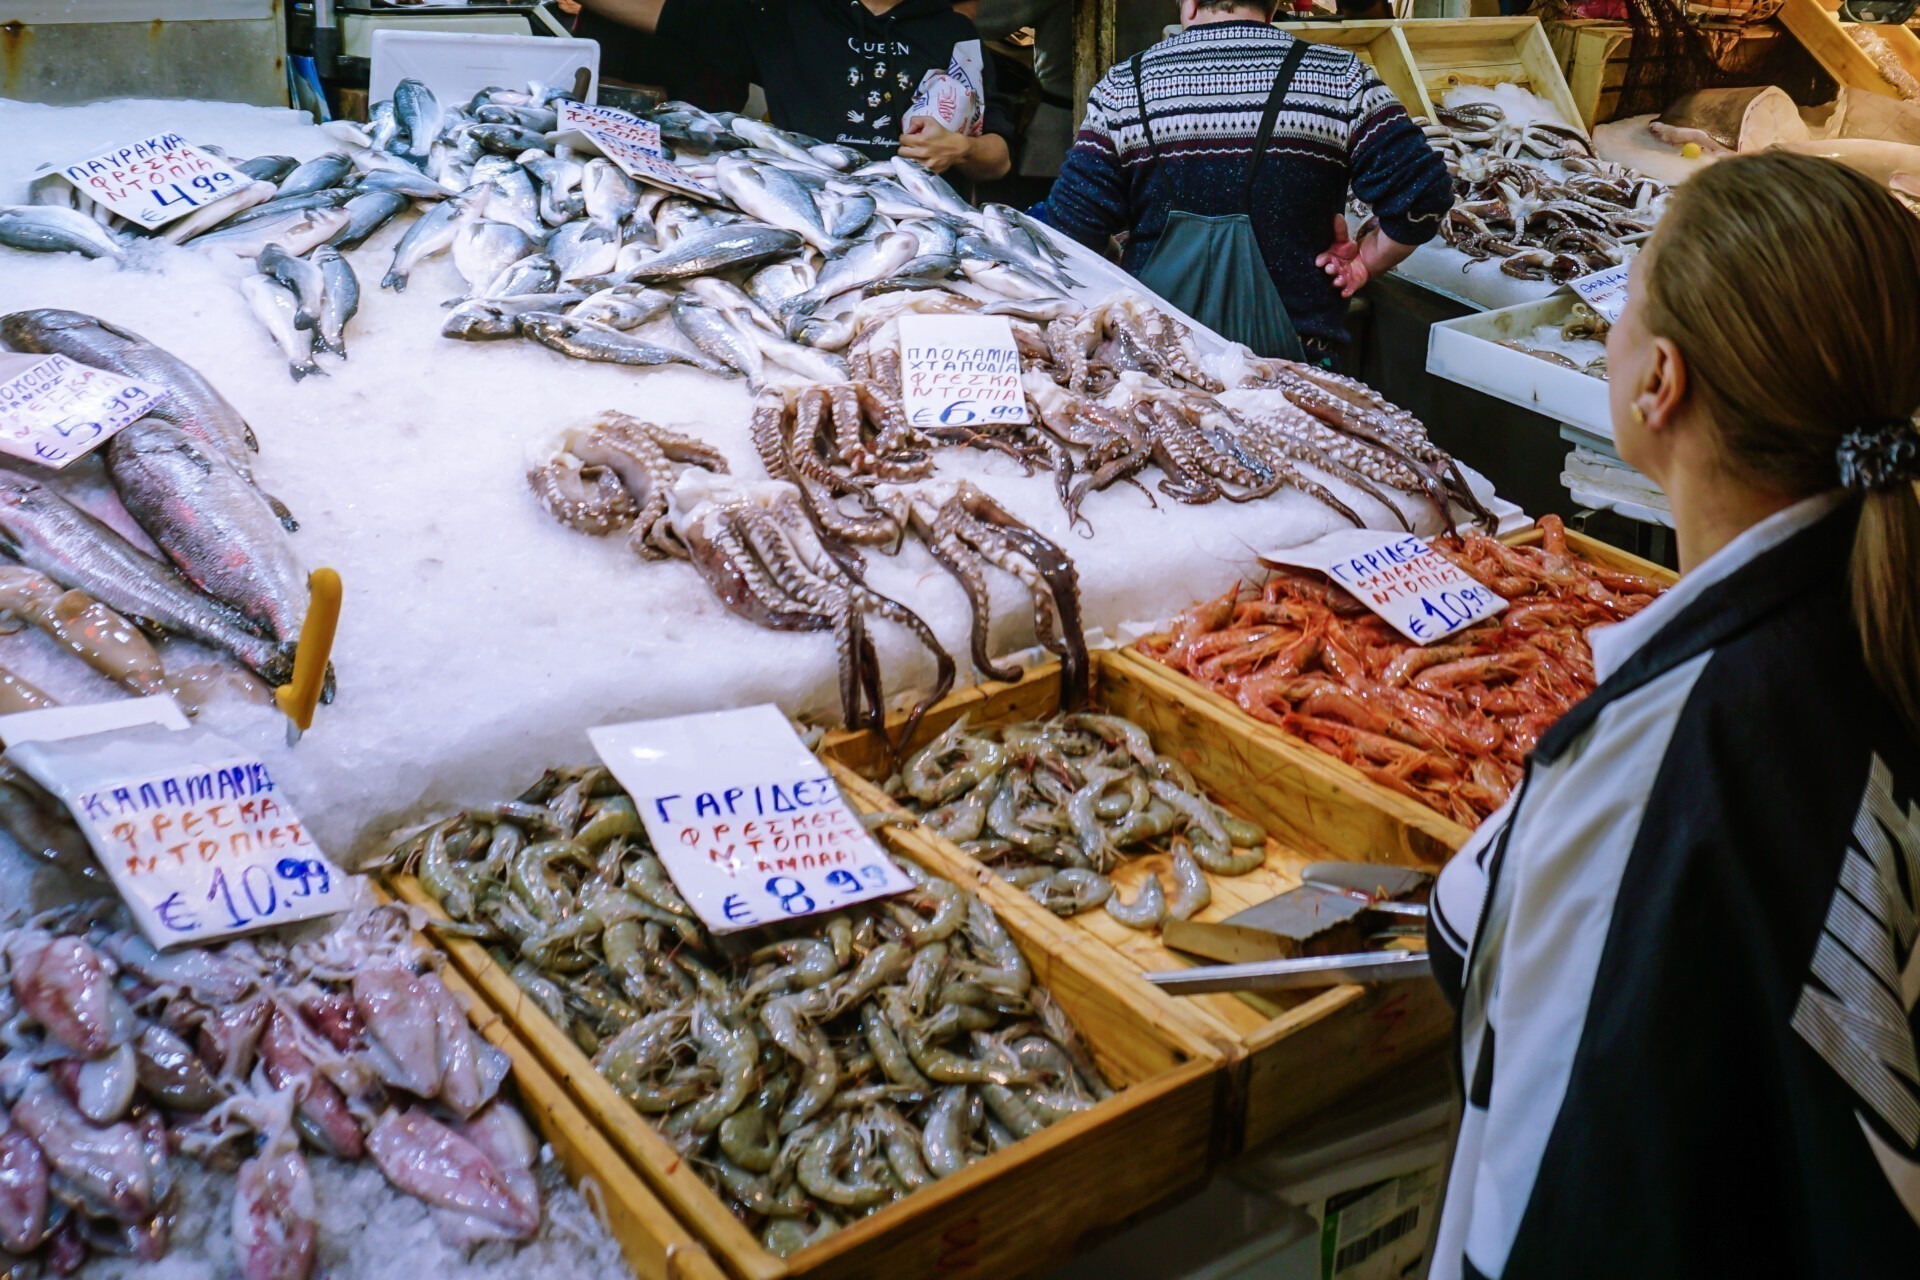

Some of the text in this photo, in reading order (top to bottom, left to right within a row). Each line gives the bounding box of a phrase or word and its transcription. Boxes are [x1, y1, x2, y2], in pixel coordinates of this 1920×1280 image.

[89, 148, 196, 191] ΦΡΕΣΚΑ
[105, 158, 213, 202] ΝΤΟΠΙΑ
[0, 356, 71, 405] ΟΚΟΠΙΑ
[0, 371, 95, 431] ΡΕΣΚΑ
[910, 372, 1018, 388] ΦΡΕΣΚΑ
[912, 386, 1016, 401] ΝΤΟΠΙΑ
[1331, 536, 1430, 583] ΓΑΡΙΔΕΣ
[1372, 567, 1469, 605] ΝΤΟΠΙΕΣ
[655, 777, 841, 824] ΓΑΡΙΔΕΣ
[112, 798, 280, 849] ΦΡΕΣΚΑ
[680, 808, 848, 848] ΦΡΕΣΚΕΣ
[708, 829, 867, 862] ΝΤΟΠΙΕΣ
[126, 822, 313, 876] ΝΤΟΠΙΕΣ
